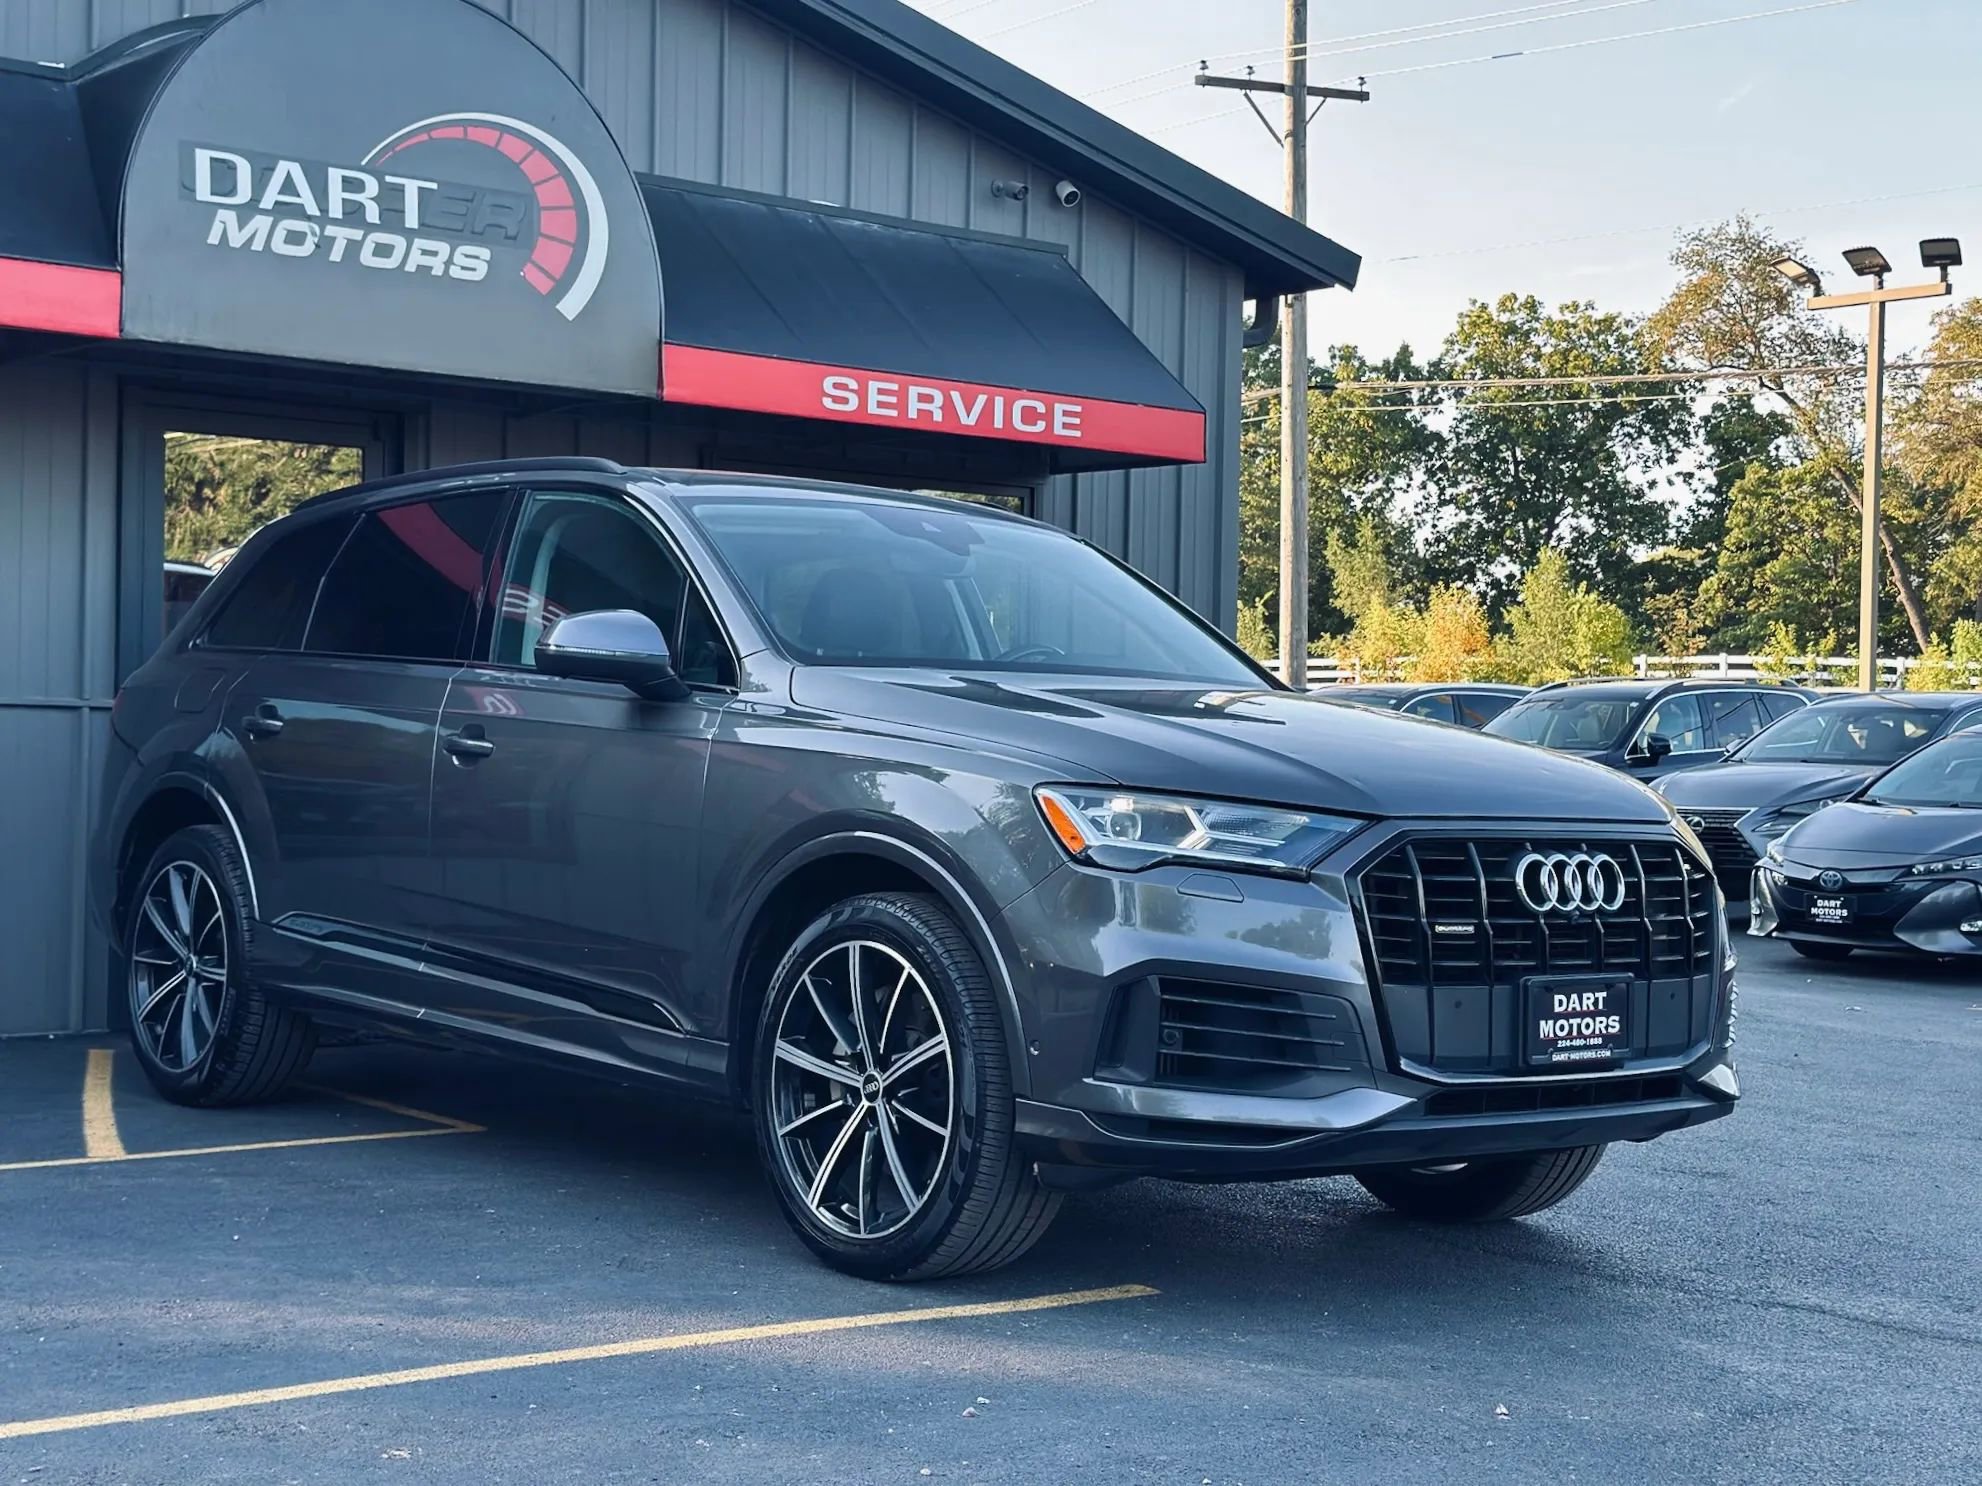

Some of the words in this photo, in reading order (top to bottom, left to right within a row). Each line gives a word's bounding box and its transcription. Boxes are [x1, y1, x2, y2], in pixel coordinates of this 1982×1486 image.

[194, 148, 438, 230] DART
[207, 209, 492, 282] MOTORS
[822, 376, 1082, 437] SERVICE
[1811, 907, 1848, 917] MOTORS
[1817, 900, 1841, 908] DART
[1553, 991, 1607, 1013] DART
[1539, 1016, 1621, 1039] MOTORS
